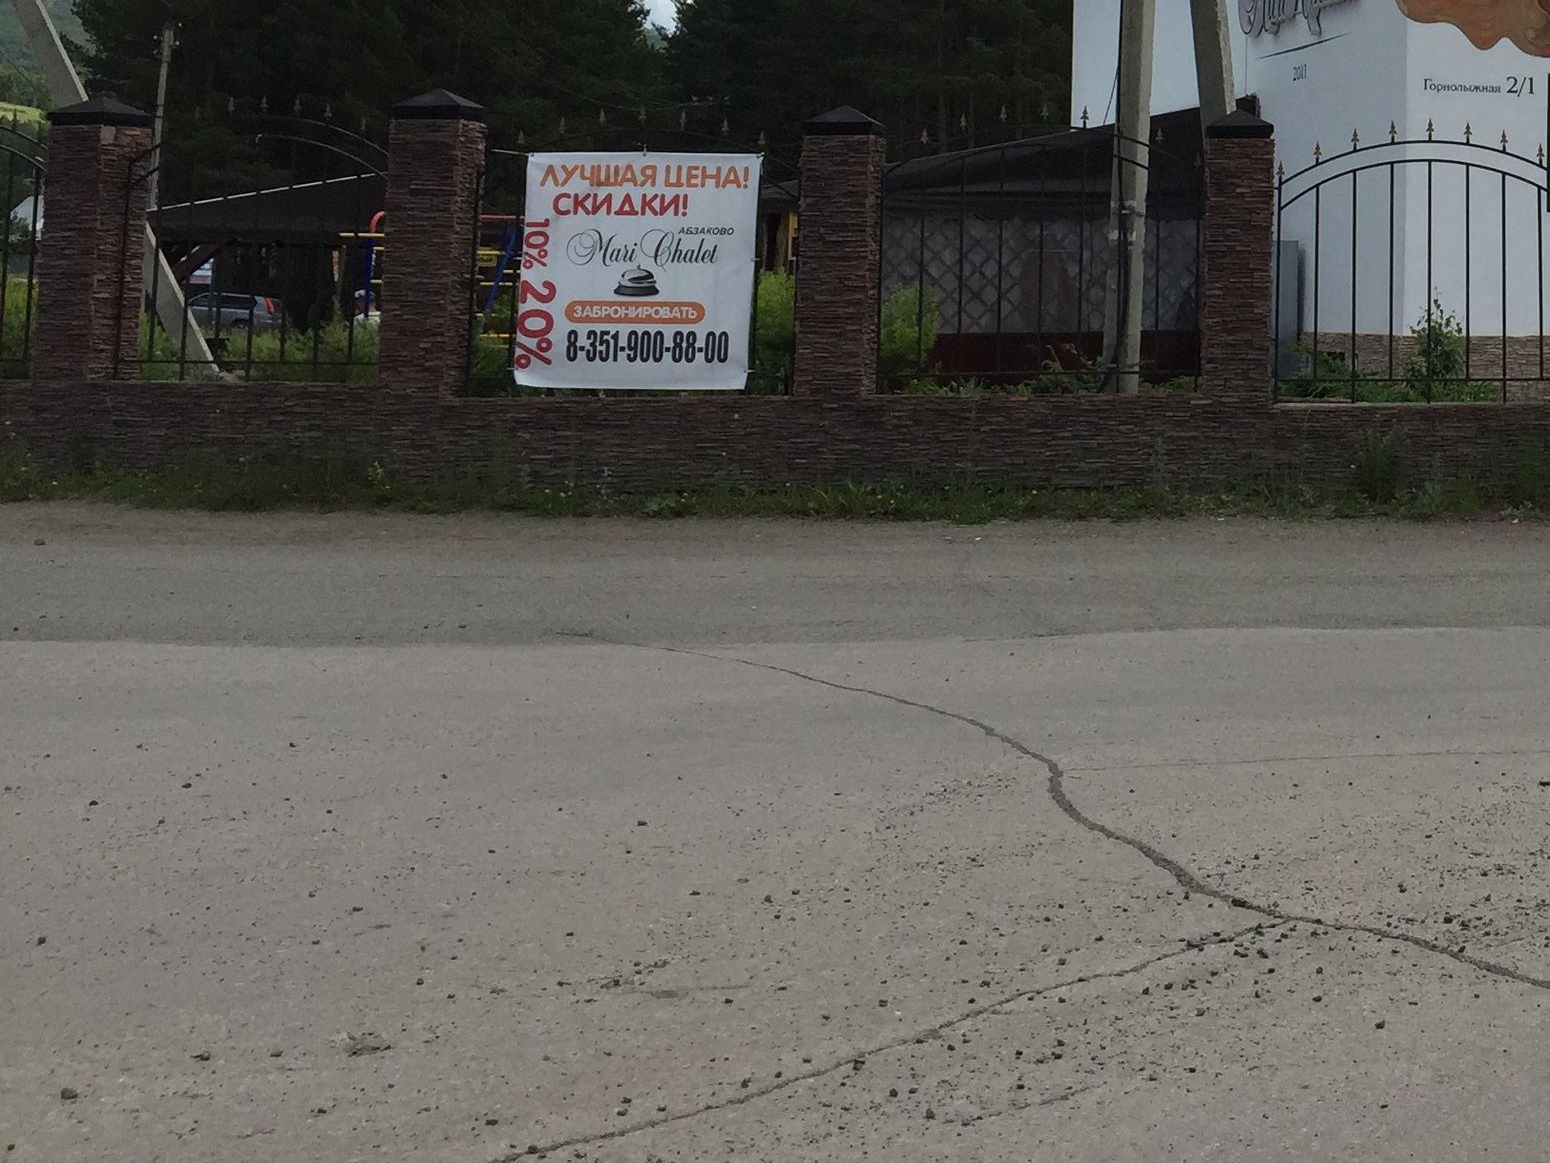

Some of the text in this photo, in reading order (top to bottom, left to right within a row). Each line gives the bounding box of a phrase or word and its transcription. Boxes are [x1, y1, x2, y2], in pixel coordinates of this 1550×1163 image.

[1423, 76, 1536, 98] Горнолыжная 2/1
[539, 164, 750, 189] ЛУЧШАЯ ЦЕНА!
[552, 192, 689, 217] СКИДКИ!
[678, 226, 735, 236] АБЗАКОВО
[566, 228, 718, 272] Mari Chalet
[514, 218, 557, 370] 10% 20%
[573, 305, 698, 319] ЗАБРОНИРОВАТЬ
[565, 329, 730, 364] 8-351-900-88-00
